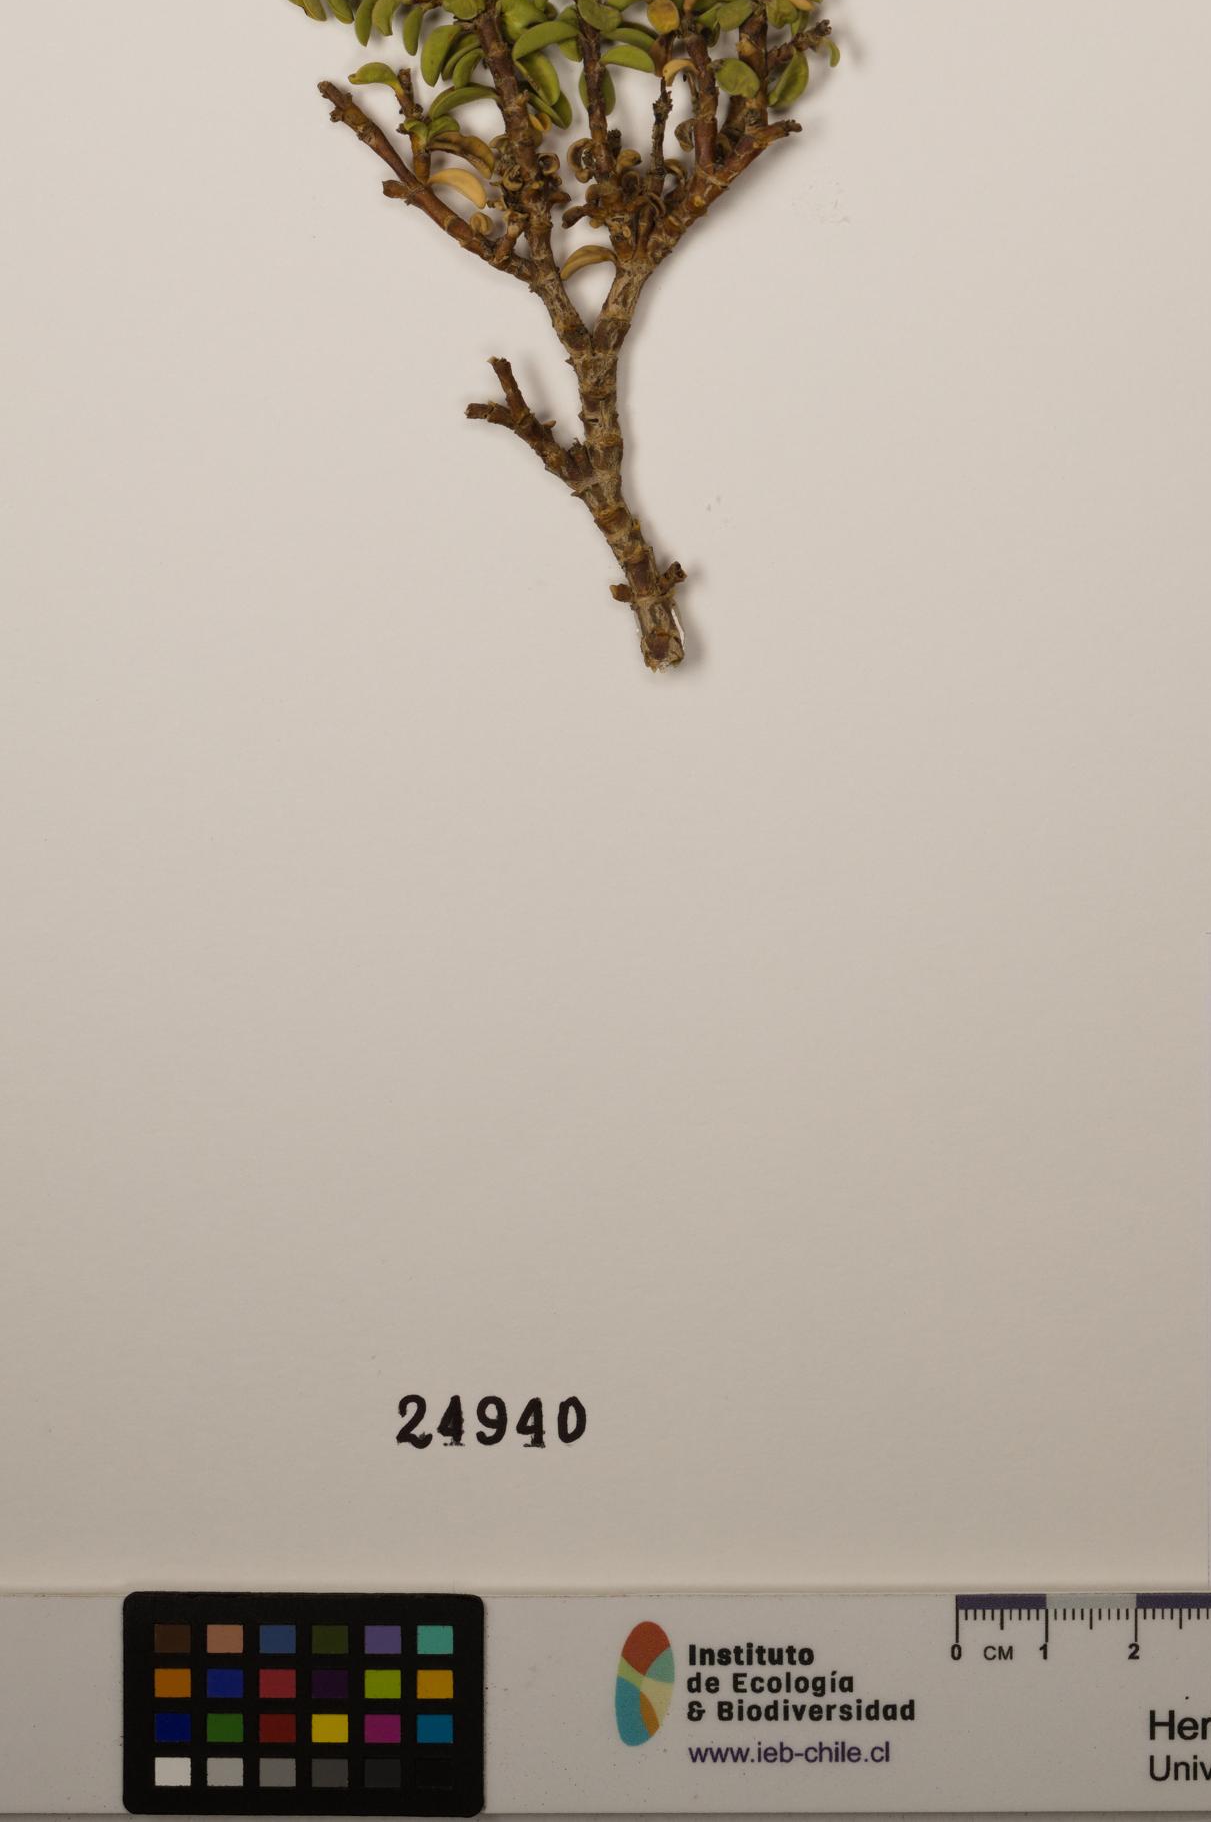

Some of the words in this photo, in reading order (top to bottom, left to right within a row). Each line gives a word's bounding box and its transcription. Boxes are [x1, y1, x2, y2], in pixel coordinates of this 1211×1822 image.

[395, 1394, 587, 1449] 24940
[688, 1642, 815, 1666] Instituto
[950, 1643, 963, 1661] 0
[983, 1645, 1014, 1661] CM
[1038, 1643, 1049, 1660] 1
[1127, 1642, 1141, 1660] 2
[686, 1671, 720, 1694] de
[732, 1670, 855, 1698] Ecología
[686, 1699, 706, 1722] &
[717, 1698, 916, 1722] Biodiversidad
[688, 1740, 891, 1764] www.ieb-chile.cl
